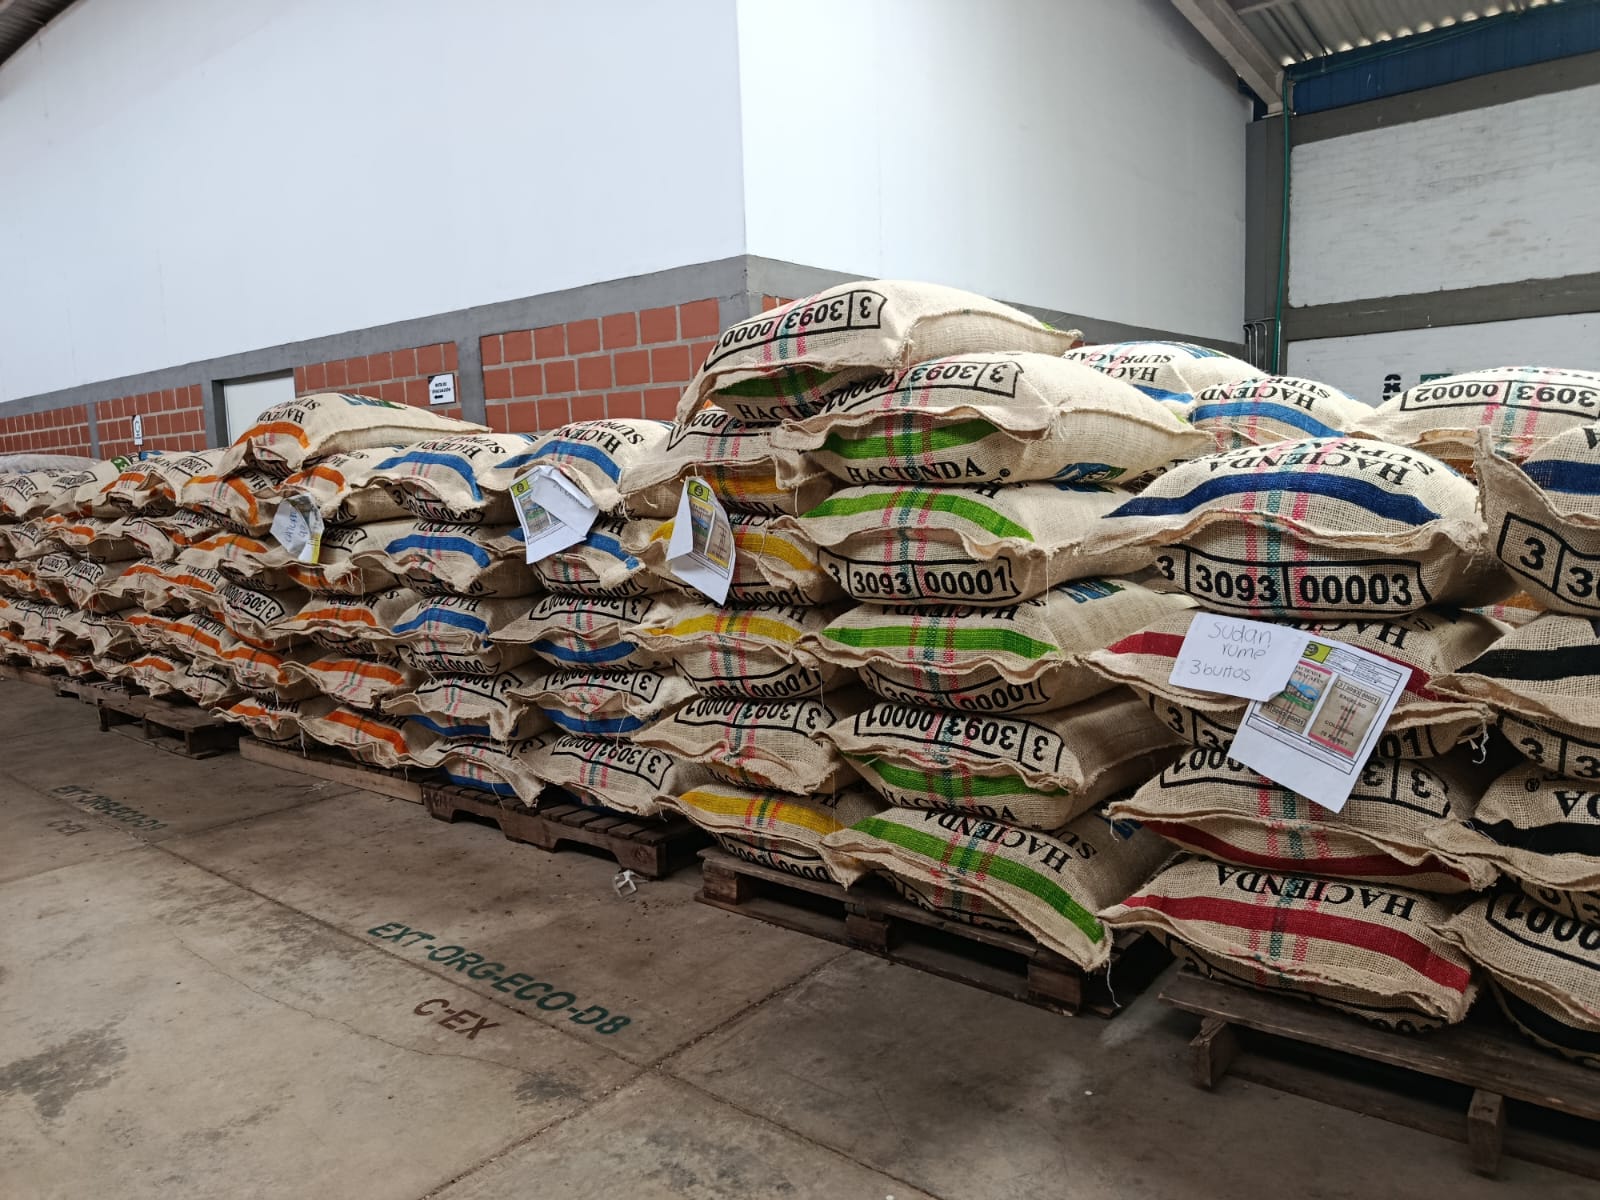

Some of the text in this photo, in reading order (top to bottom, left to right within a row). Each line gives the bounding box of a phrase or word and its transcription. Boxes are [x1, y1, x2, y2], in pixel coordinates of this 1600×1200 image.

[786, 299, 844, 330] 3093
[860, 296, 873, 318] 3
[909, 363, 973, 381] 3093
[990, 364, 1009, 381] 3
[1416, 383, 1598, 407] 3093 00002
[847, 458, 986, 483] HACIENDA
[1209, 452, 1412, 487] HACIENDA
[1519, 537, 1547, 570] 3
[854, 574, 912, 595] 3093
[924, 567, 1009, 595] 00001
[1157, 555, 1414, 605] 3 3093 00003
[638, 674, 653, 691] 3
[806, 707, 822, 728] 3
[866, 704, 1050, 758] 3 3093 00001
[1168, 705, 1184, 734] 3
[601, 741, 643, 766] 3093
[647, 755, 663, 774] 3
[1411, 767, 1432, 799] 3
[924, 808, 1074, 875] HACIENDA
[1215, 865, 1420, 921] HACIENDA
[367, 922, 632, 1035] EXT-ORG-ECO-D8
[413, 998, 501, 1040] C-EX
